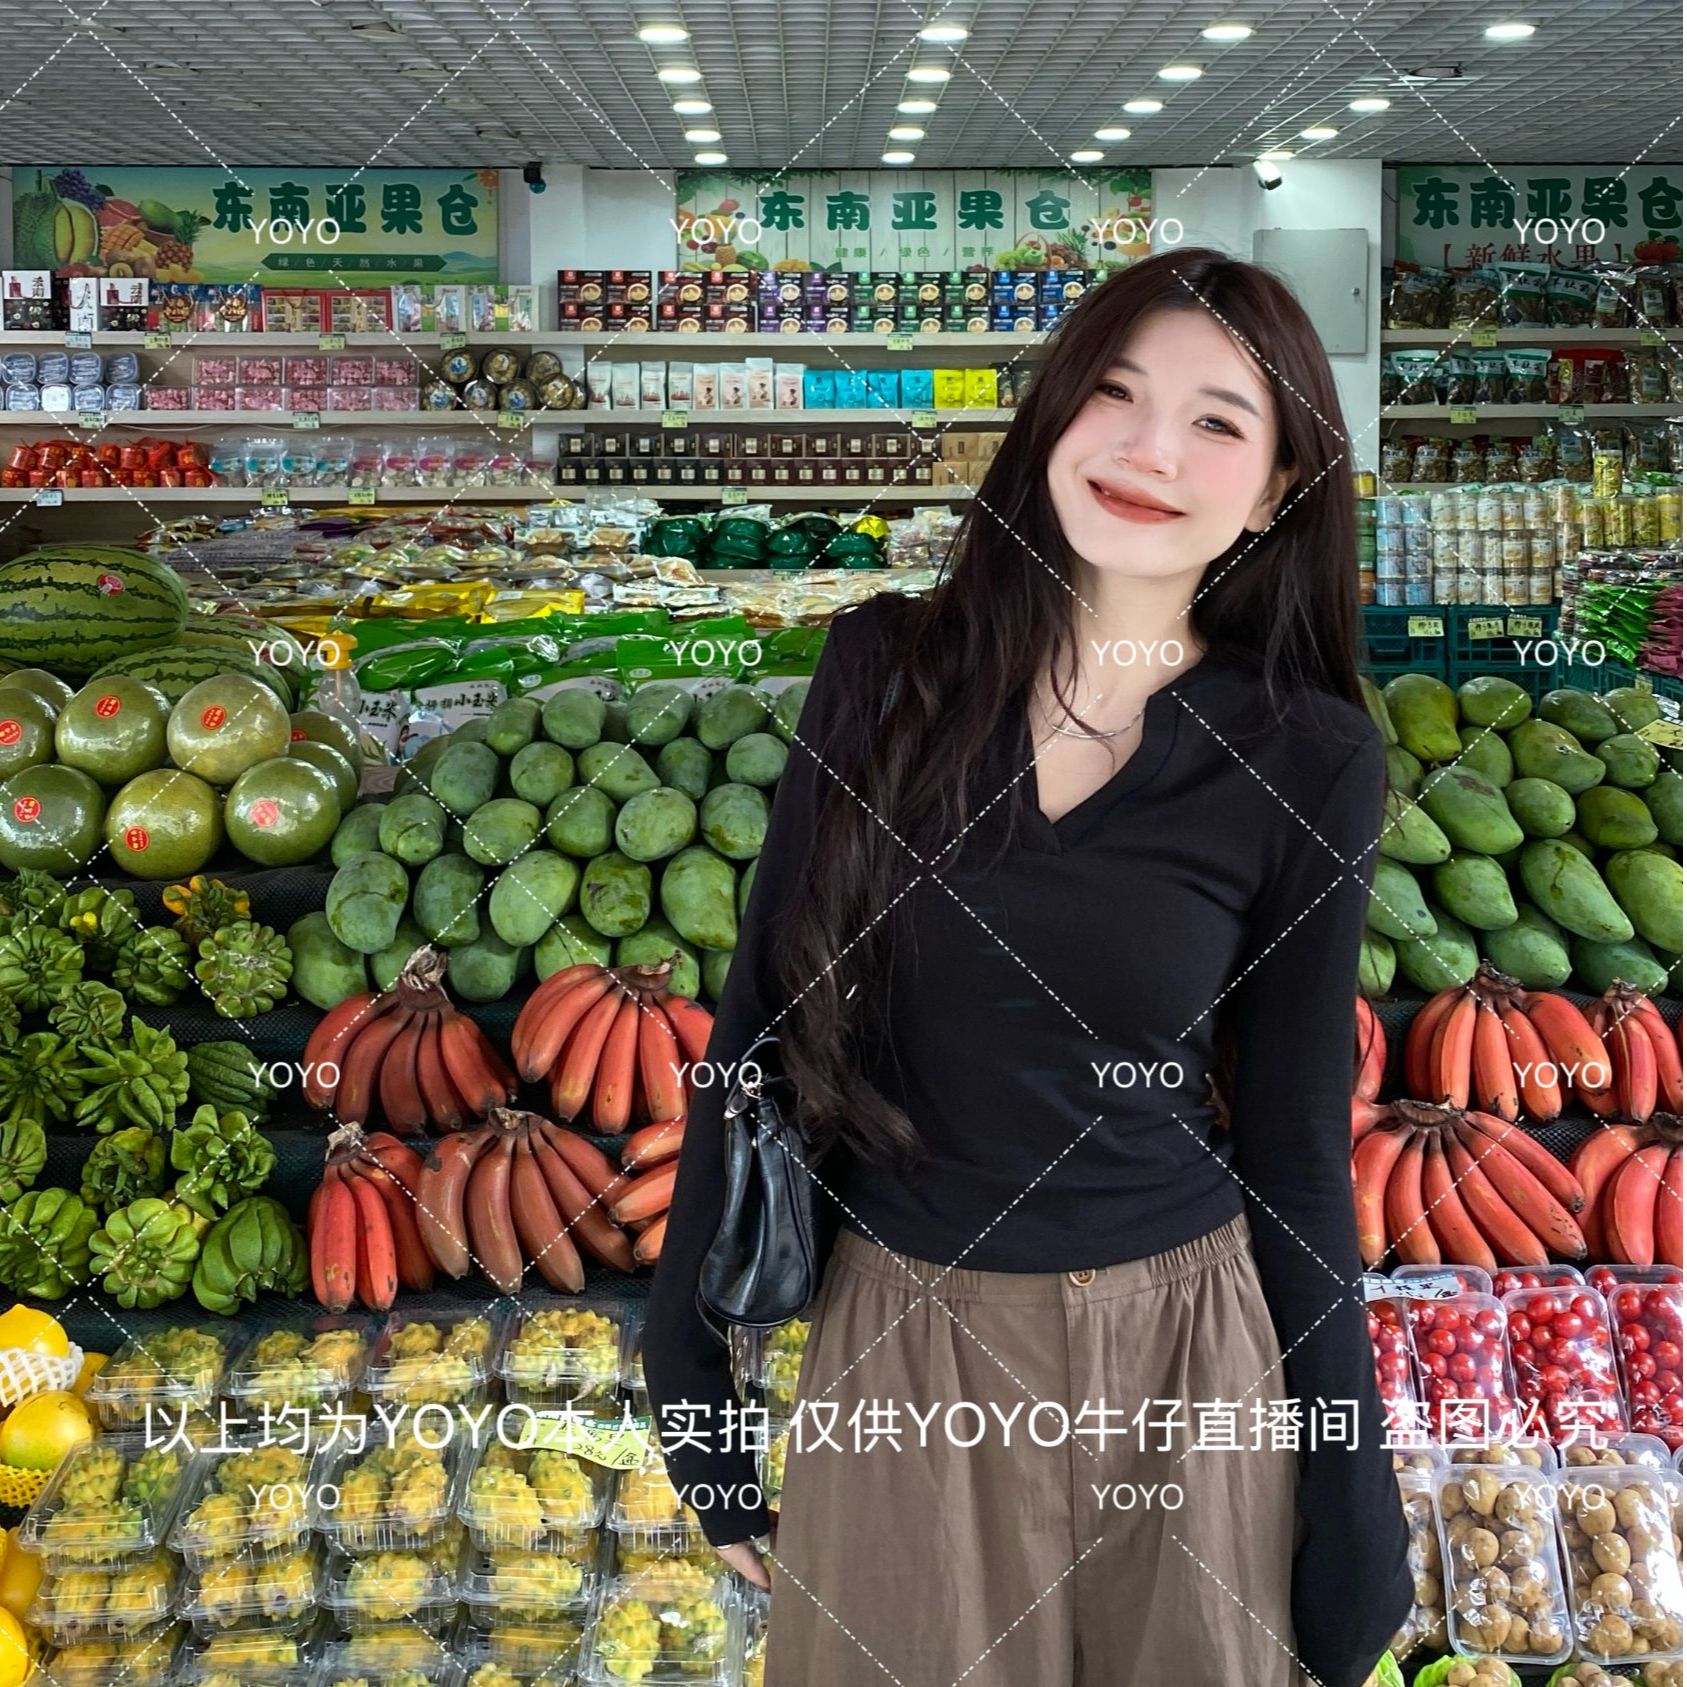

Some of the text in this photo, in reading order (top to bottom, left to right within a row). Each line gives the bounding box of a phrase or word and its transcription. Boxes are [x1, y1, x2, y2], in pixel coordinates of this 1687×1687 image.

[212, 181, 478, 235] 东南亚果仓
[759, 190, 1070, 231] 东南亚果仓
[1413, 176, 1683, 229] 东南亚果仓
